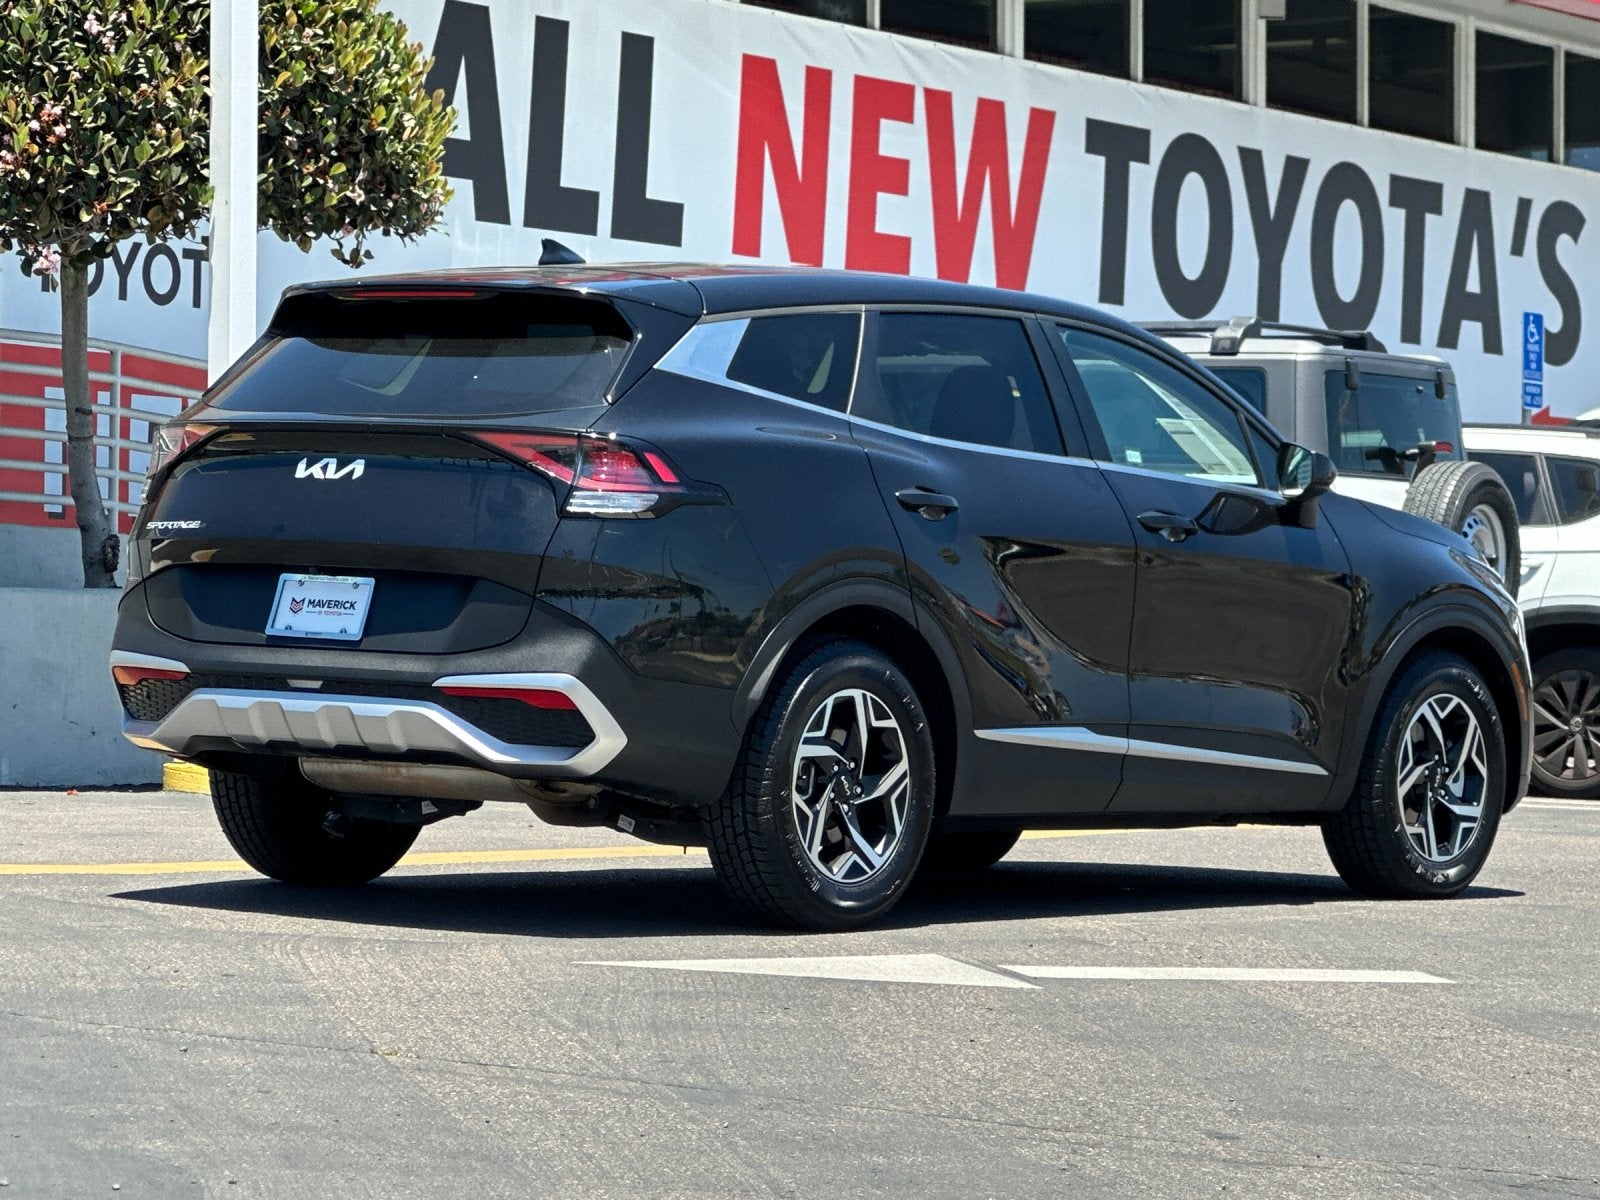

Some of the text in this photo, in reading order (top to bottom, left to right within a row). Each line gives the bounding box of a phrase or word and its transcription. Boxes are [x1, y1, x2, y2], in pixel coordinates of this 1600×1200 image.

[423, 0, 1586, 367] ALL NEW TOYOTA'S
[295, 457, 366, 480] KIA
[145, 520, 201, 530] SPORTAGE
[307, 598, 357, 610] MAVERICK
